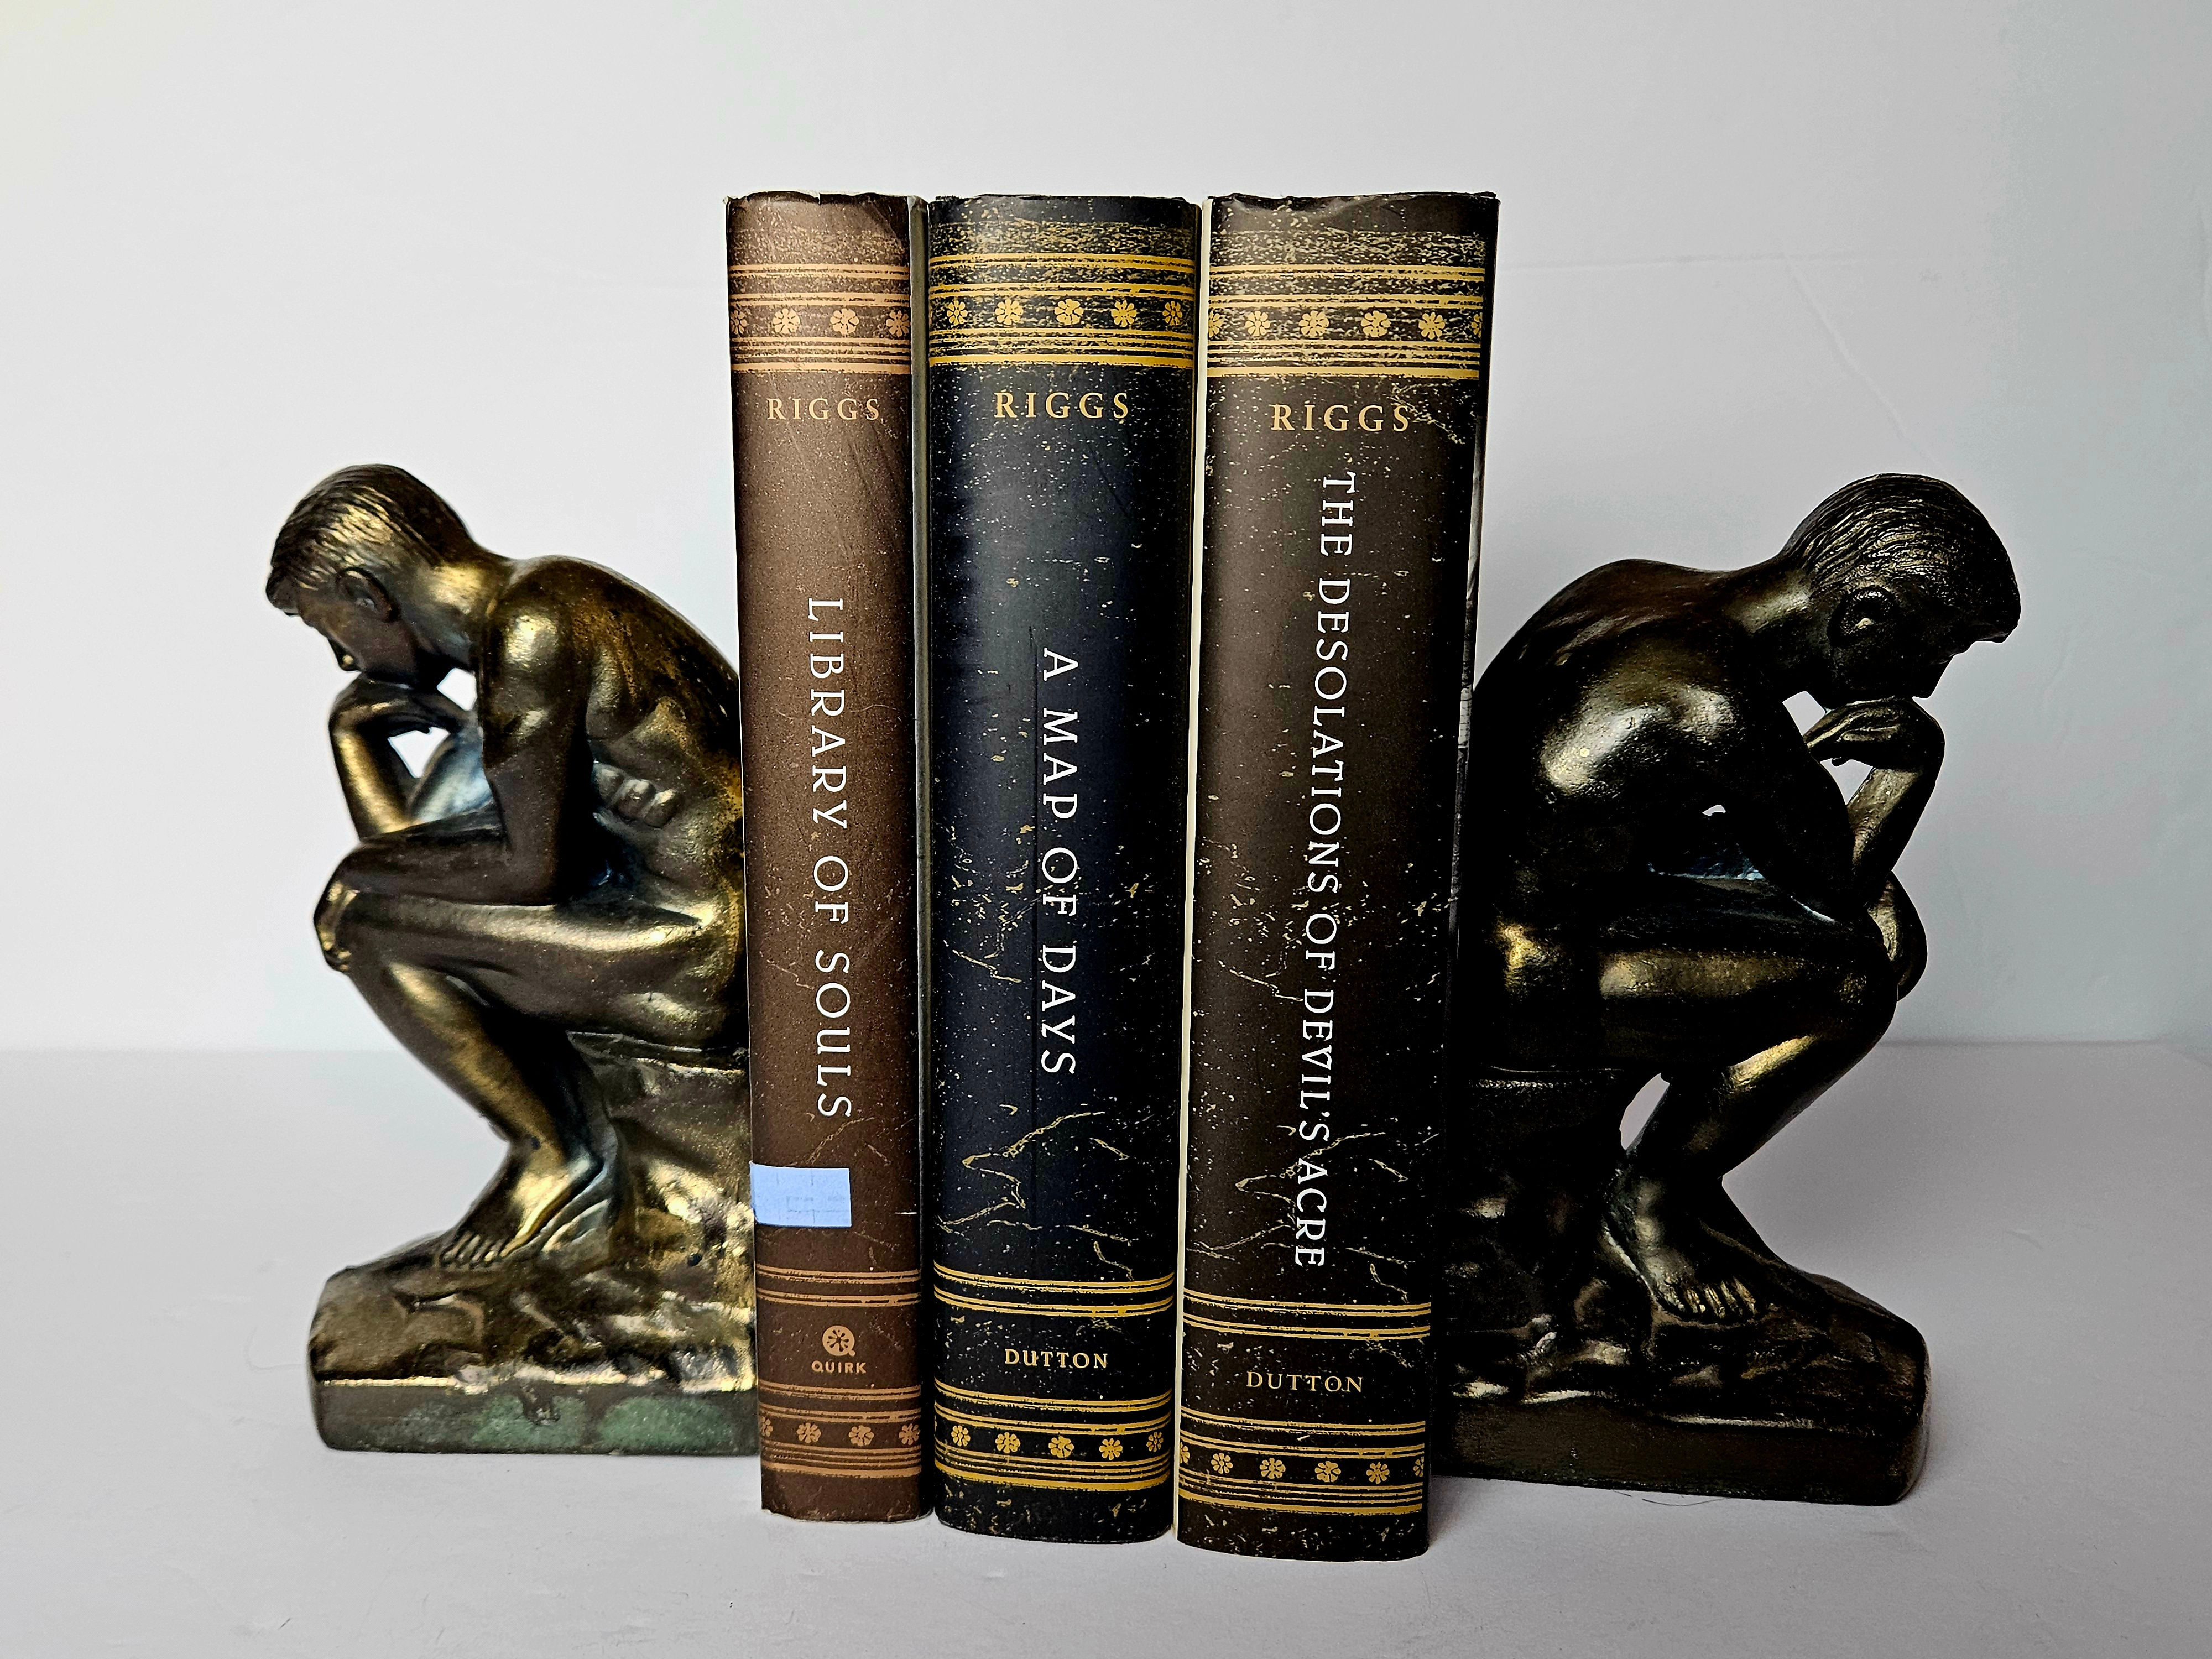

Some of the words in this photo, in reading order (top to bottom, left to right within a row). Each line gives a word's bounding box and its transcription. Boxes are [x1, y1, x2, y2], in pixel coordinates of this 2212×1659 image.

[766, 398, 880, 421] RIGGS
[994, 392, 1129, 419] RIGGS
[1270, 404, 1409, 432] RIGGS
[1319, 471, 1357, 557] THE
[1043, 646, 1079, 682] A
[807, 597, 848, 830] LIBRARY
[1307, 577, 1351, 894] DESOLATIONS
[1042, 707, 1078, 820] MAP
[813, 855, 849, 925] OF
[1041, 847, 1079, 917] OF
[1305, 912, 1338, 971] OF
[815, 949, 852, 1118] SOULS
[1040, 943, 1077, 1076] DAYS
[1298, 988, 1334, 1142] DEVIL'S
[1295, 1157, 1329, 1267] ACRE
[811, 1360, 867, 1374] QUIRK
[1004, 1348, 1108, 1369] DUTTON
[1246, 1371, 1364, 1392] DUTTON
